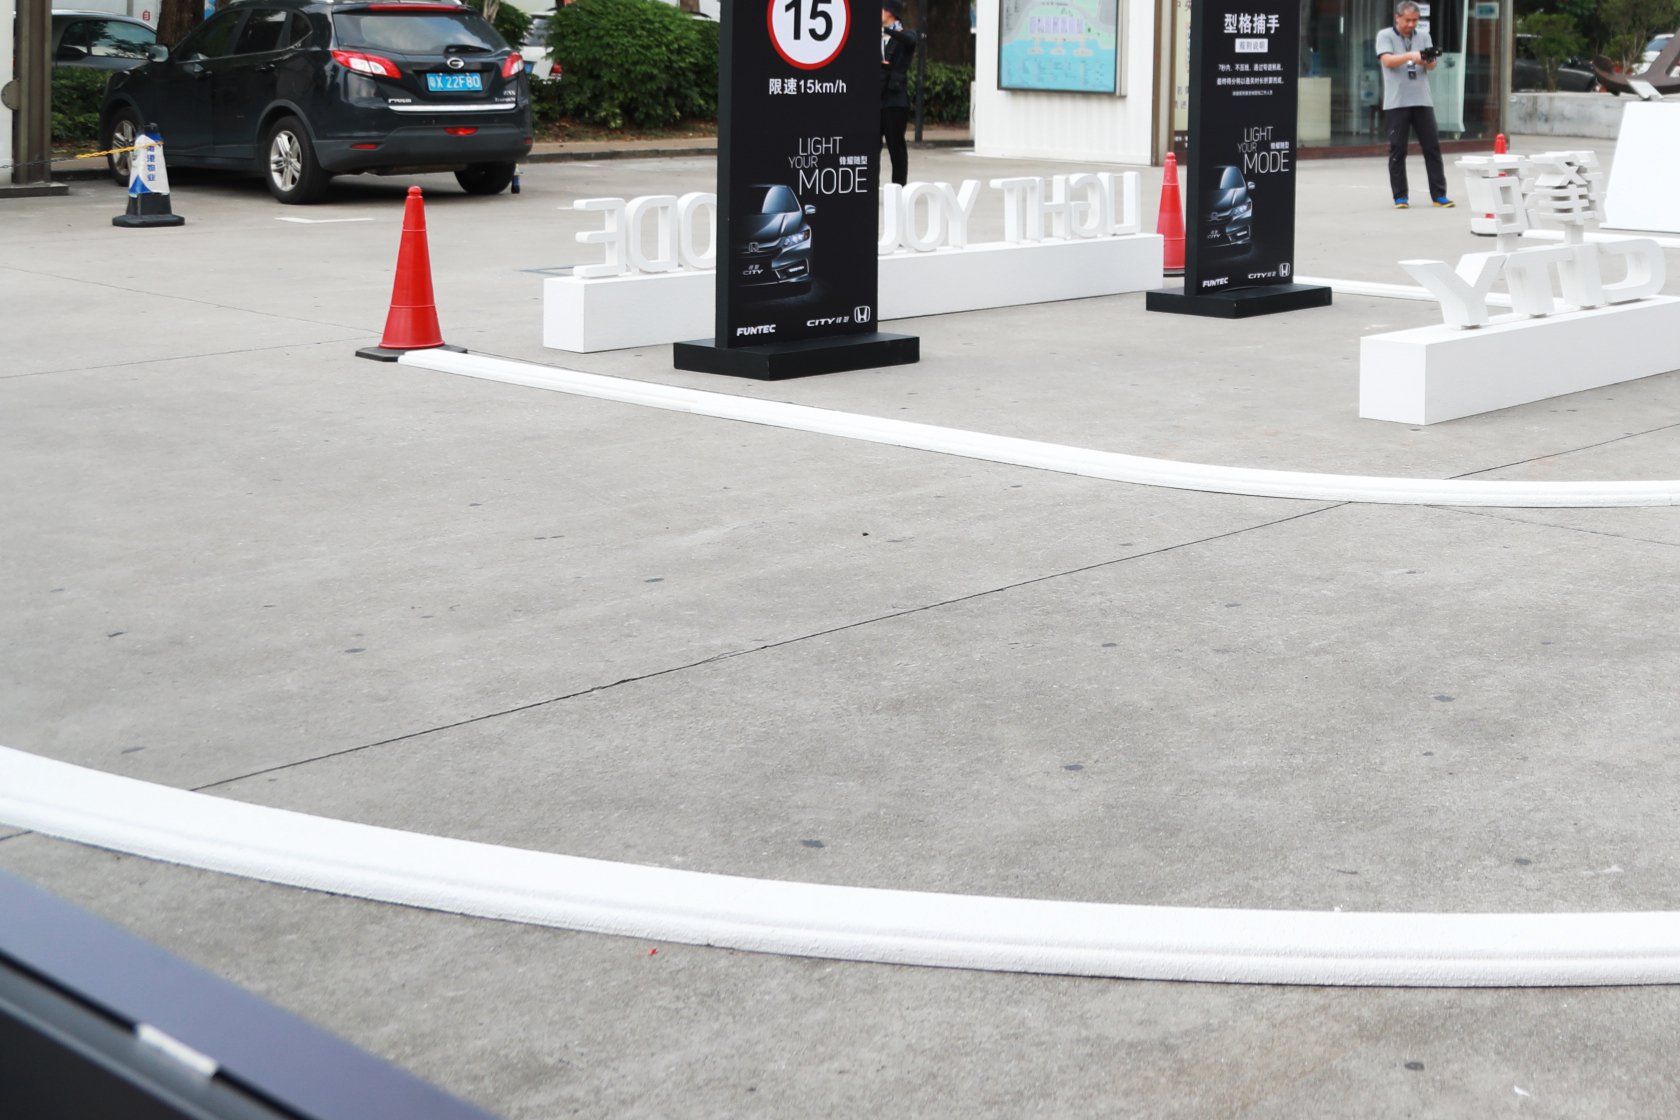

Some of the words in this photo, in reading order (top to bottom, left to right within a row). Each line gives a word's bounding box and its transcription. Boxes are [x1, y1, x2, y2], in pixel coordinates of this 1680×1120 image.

[1223, 12, 1280, 34] 型格捕手
[768, 78, 847, 95] 限速15km/h
[1244, 126, 1273, 142] LIGHT
[799, 136, 843, 156] LIGHT
[1237, 142, 1257, 153] YOUR
[788, 156, 818, 169] YOUR
[1244, 150, 1289, 174] MODE
[799, 166, 868, 195] MODE
[1202, 277, 1229, 288] FUNTEC
[736, 324, 776, 336] FUNTEC
[806, 317, 836, 327] CITY
